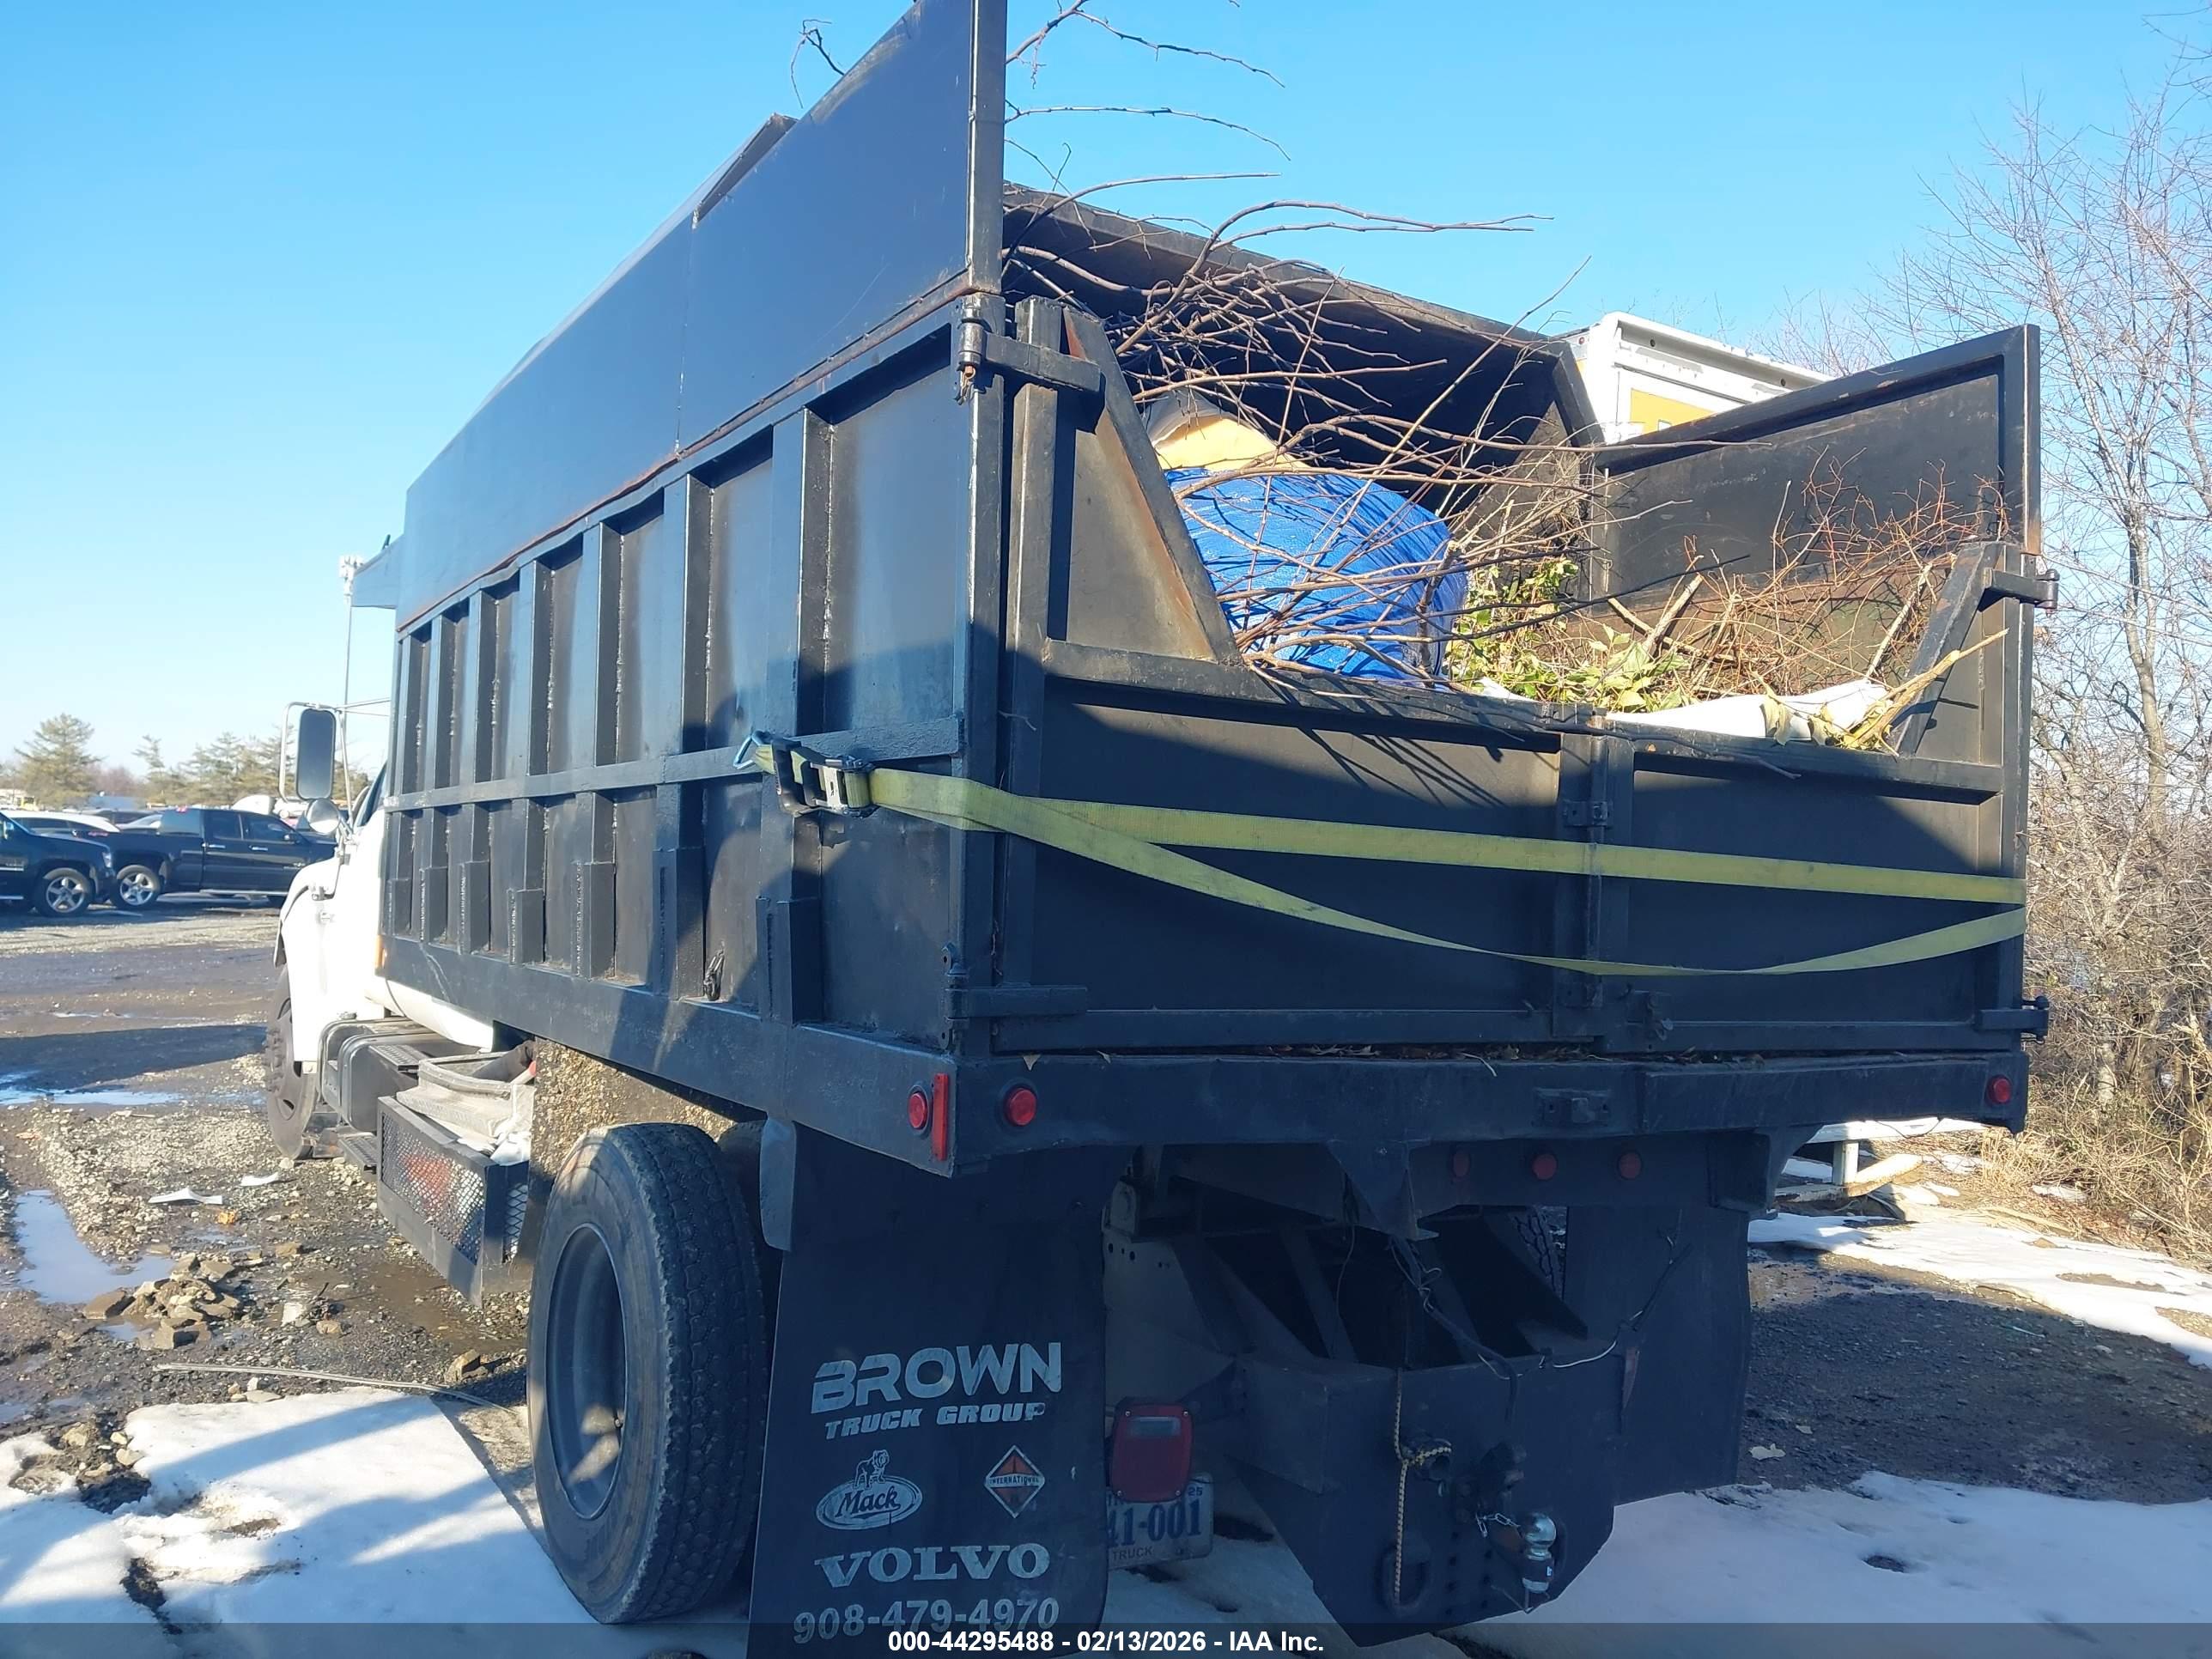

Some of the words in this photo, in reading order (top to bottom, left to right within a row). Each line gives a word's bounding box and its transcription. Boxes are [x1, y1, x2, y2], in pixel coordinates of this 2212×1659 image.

[811, 1341, 1062, 1414] BROWN
[825, 1407, 922, 1440] TRUCK
[936, 1402, 1045, 1425] GROUP
[835, 1486, 900, 1518] Mack
[1187, 1486, 1203, 1497] 25
[814, 1542, 1050, 1588] VOLVO
[1112, 1547, 1153, 1560] TRUCK
[793, 1597, 1060, 1644] 908-479-4970
